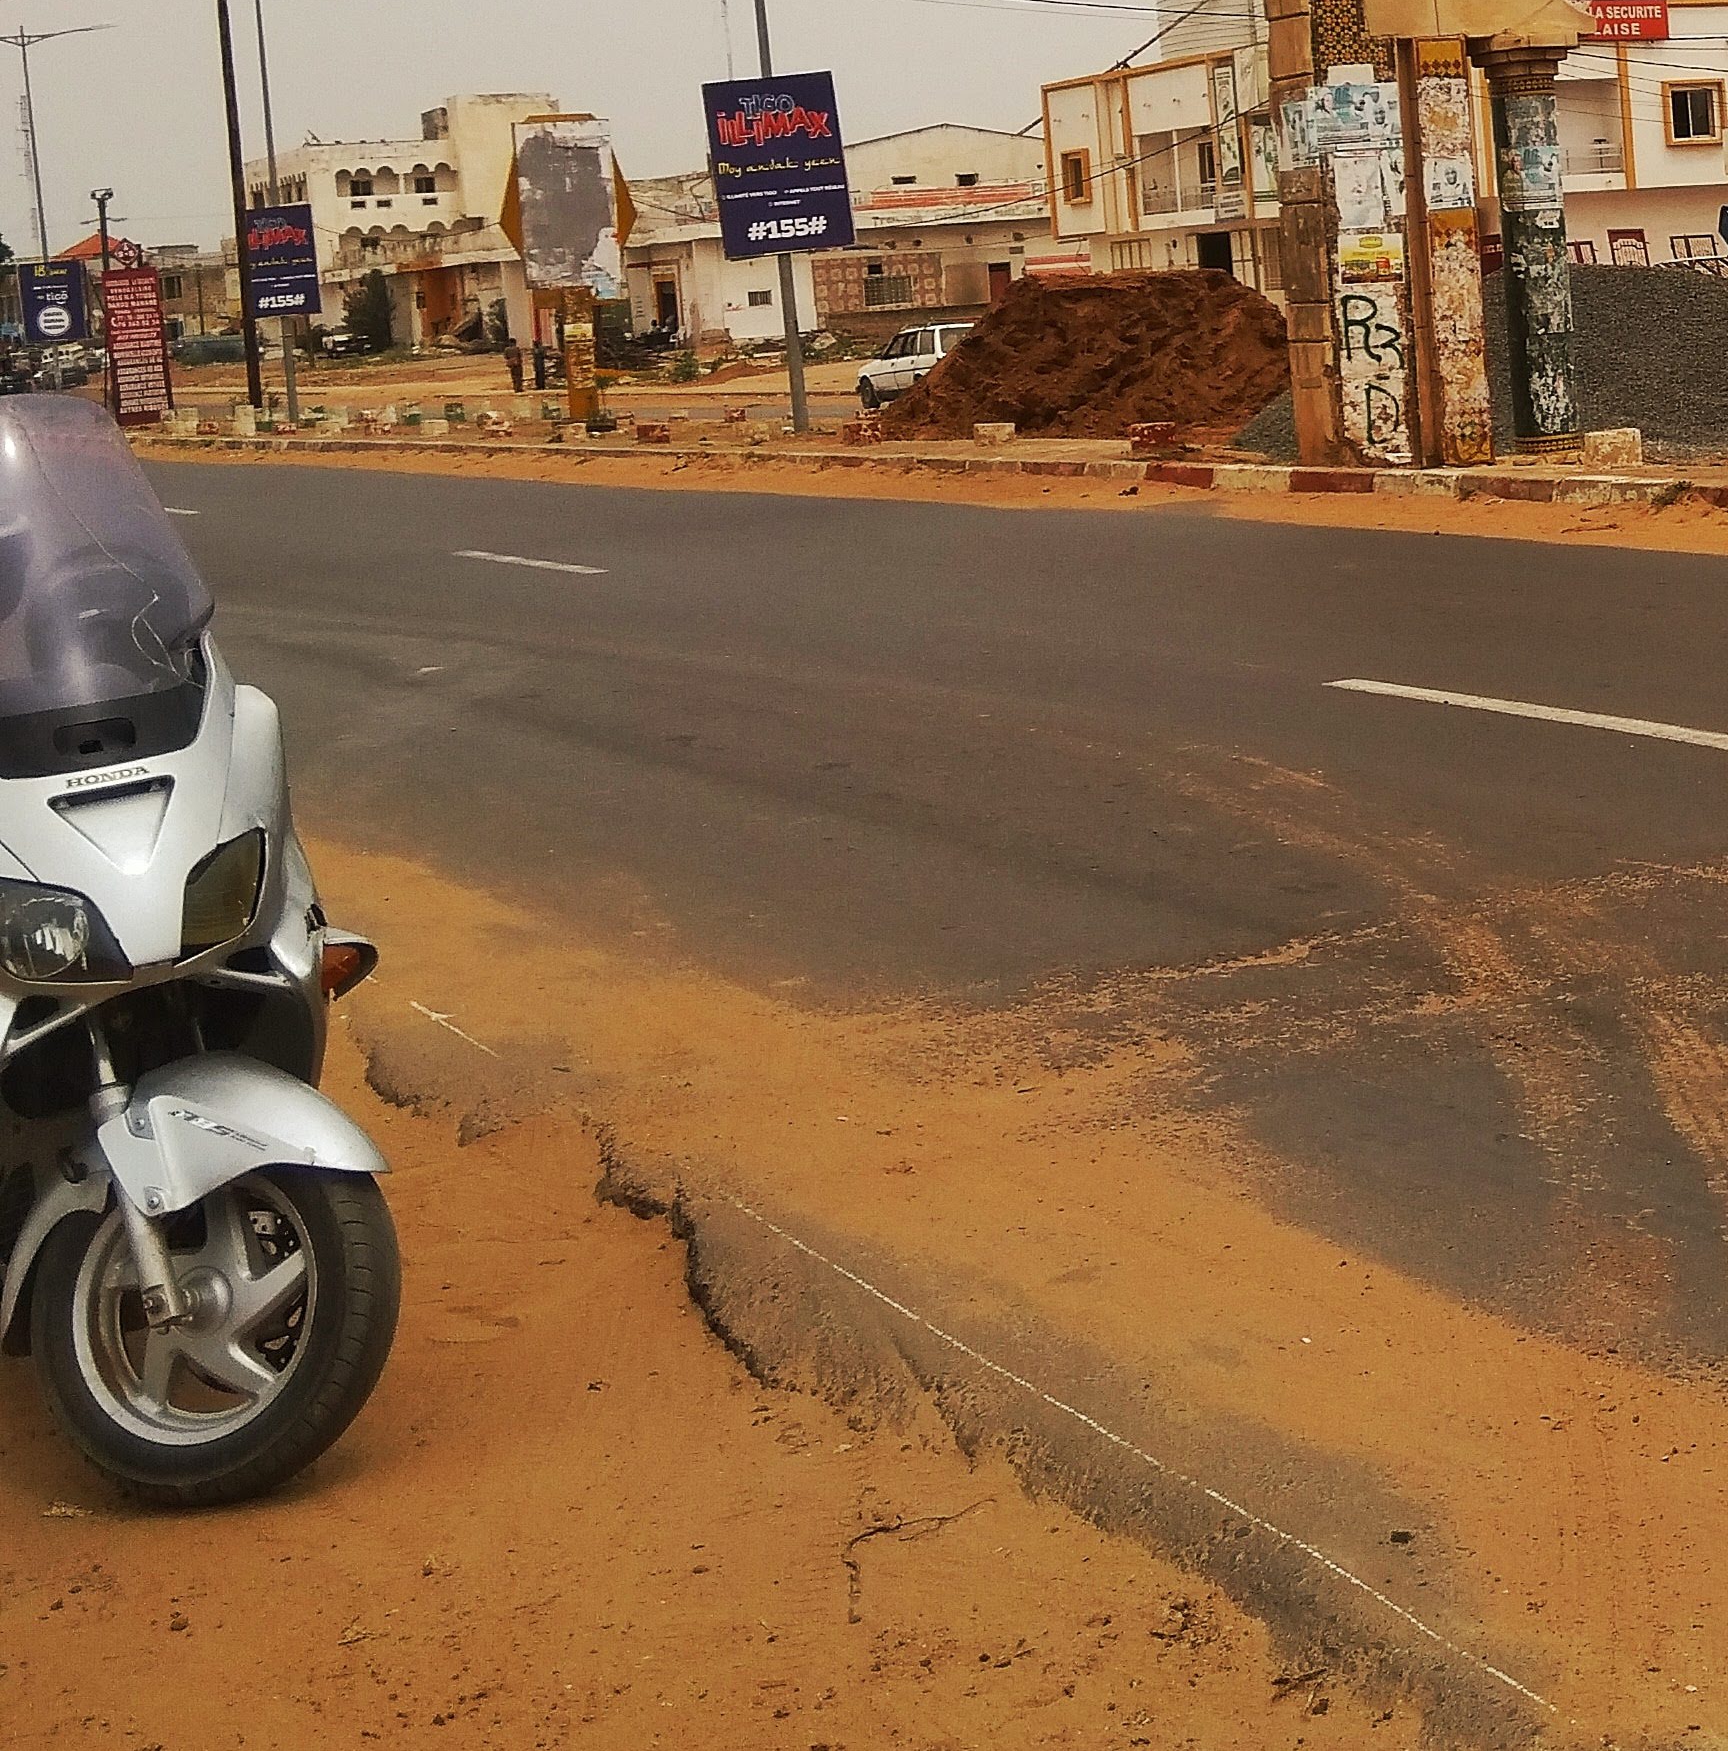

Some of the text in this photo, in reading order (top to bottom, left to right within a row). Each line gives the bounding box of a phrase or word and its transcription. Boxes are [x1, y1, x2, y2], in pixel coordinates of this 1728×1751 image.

[1606, 6, 1663, 19] SECURITE
[739, 94, 794, 119] TIGO
[747, 215, 827, 241] #155#
[258, 293, 305, 309] #155#
[66, 766, 150, 788] HONDA
